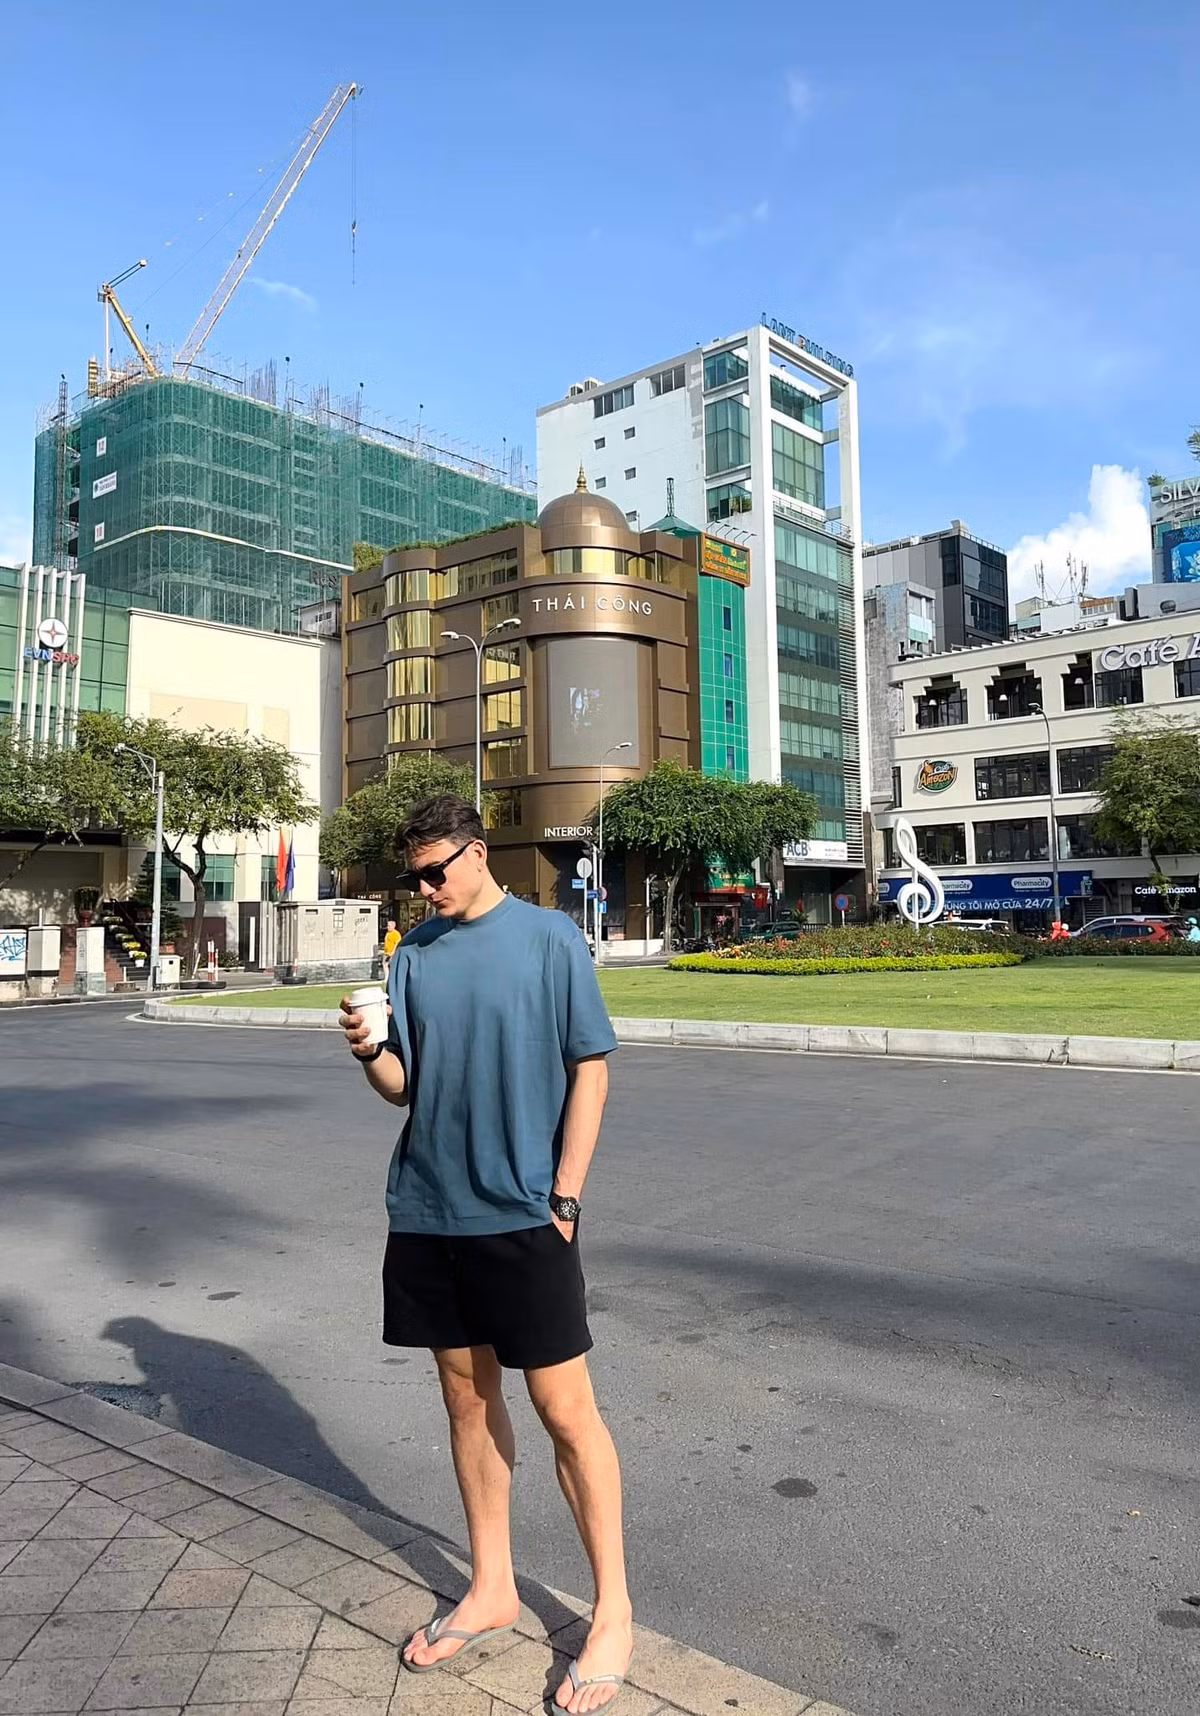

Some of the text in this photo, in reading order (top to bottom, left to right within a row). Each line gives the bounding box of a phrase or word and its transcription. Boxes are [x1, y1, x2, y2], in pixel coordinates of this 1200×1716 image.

[532, 592, 653, 616] THÁI CÔNG
[1100, 634, 1179, 671] Café
[544, 826, 593, 837] INTERIOR
[786, 841, 809, 857] ACB
[942, 880, 971, 891] harmacity
[1013, 877, 1050, 887] Pharmacity
[1158, 886, 1197, 894] mazon
[943, 900, 966, 911] HÚNG
[968, 899, 983, 910] TÔI
[1024, 898, 1053, 909] 24/7
